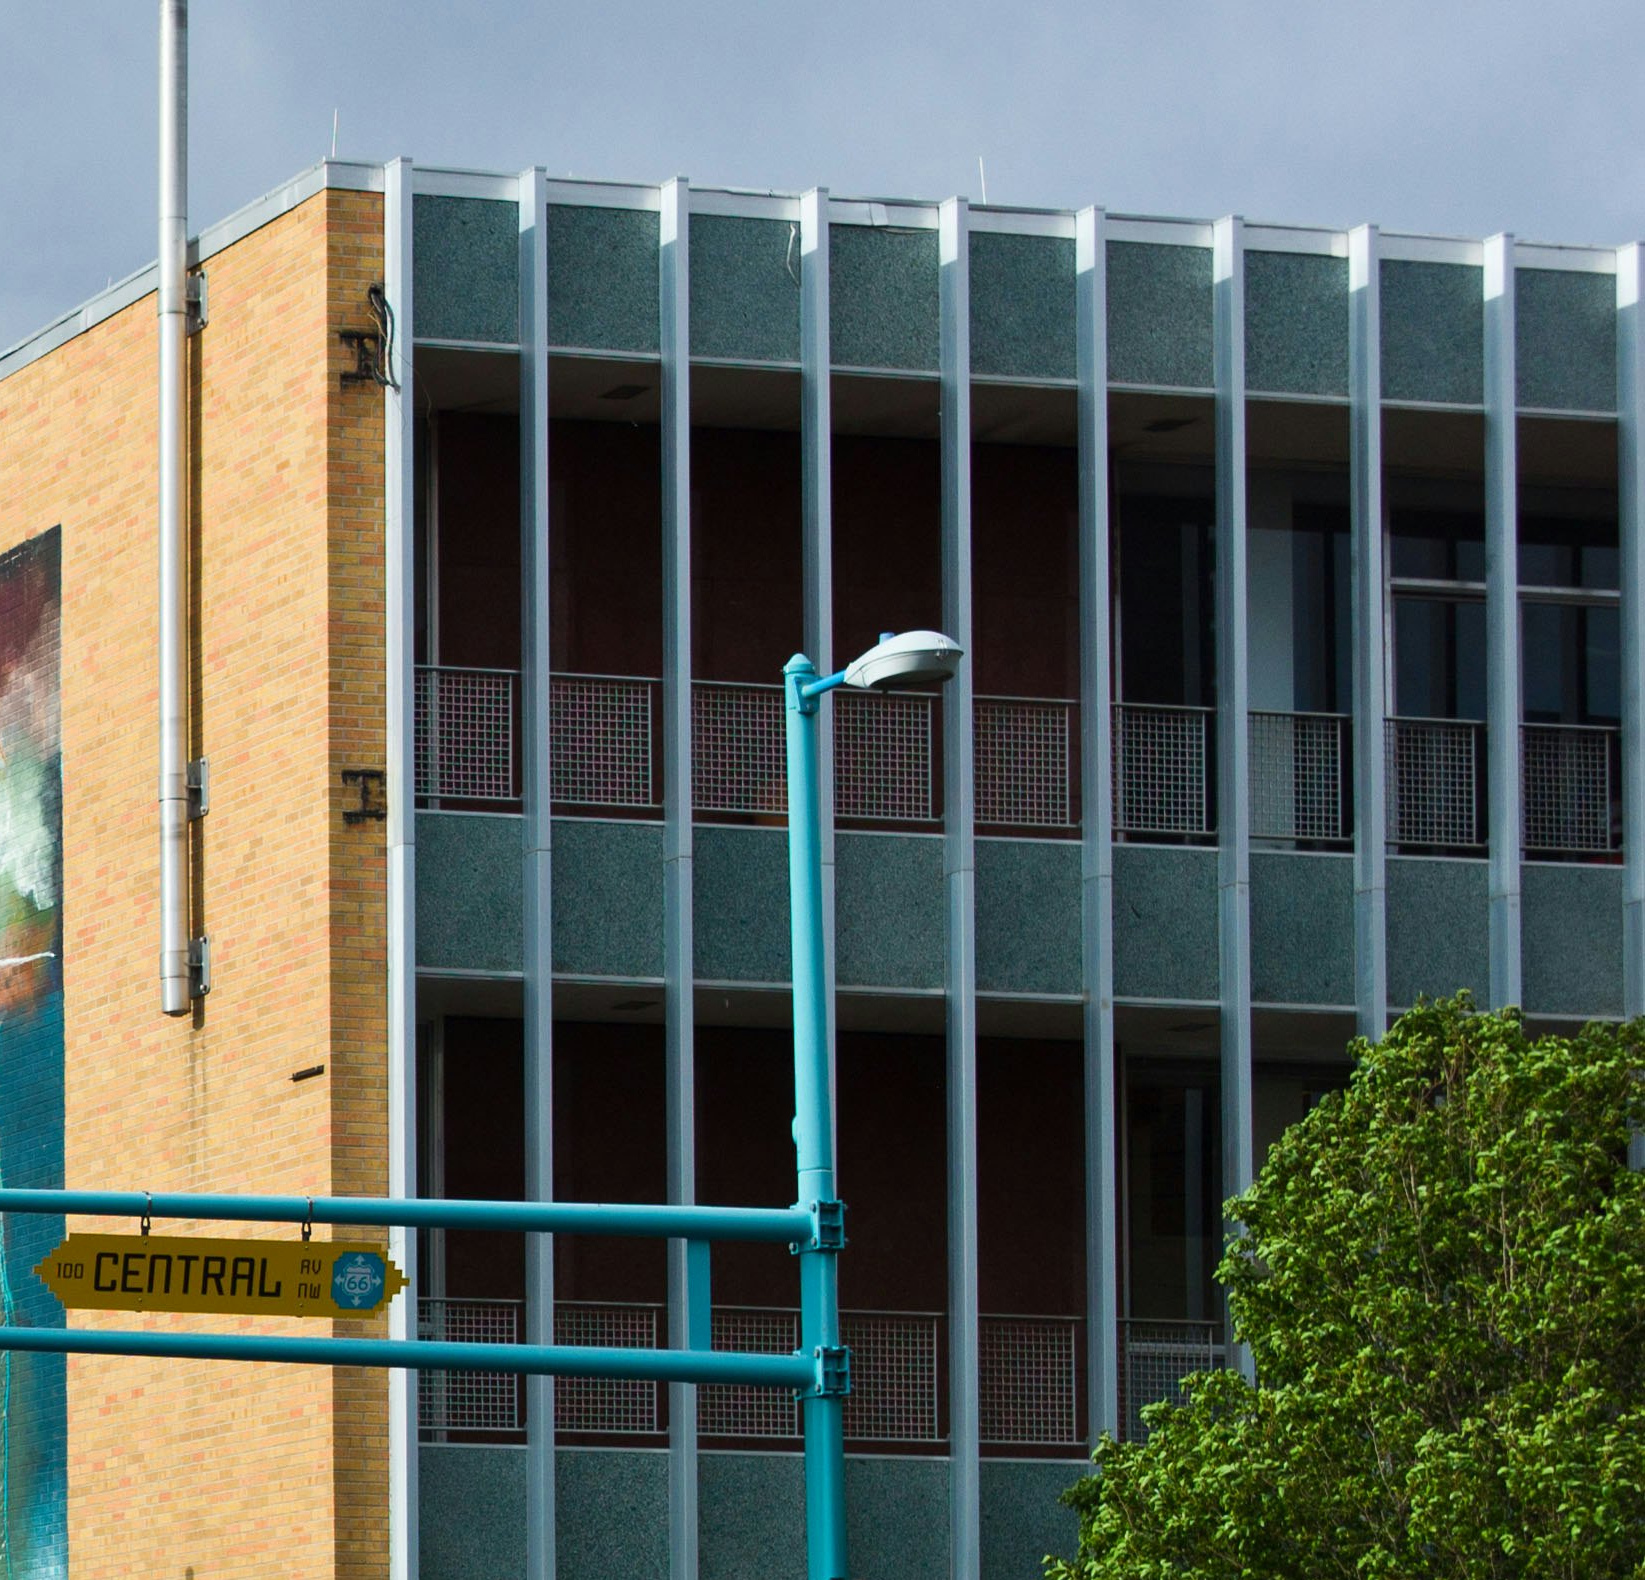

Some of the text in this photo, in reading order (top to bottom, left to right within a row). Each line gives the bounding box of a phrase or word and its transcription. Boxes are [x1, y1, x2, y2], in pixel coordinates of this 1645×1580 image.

[56, 1252, 281, 1298] 100 CENTRAL
[300, 1259, 322, 1275] AV
[297, 1283, 321, 1299] NW
[347, 1276, 369, 1291] 66
